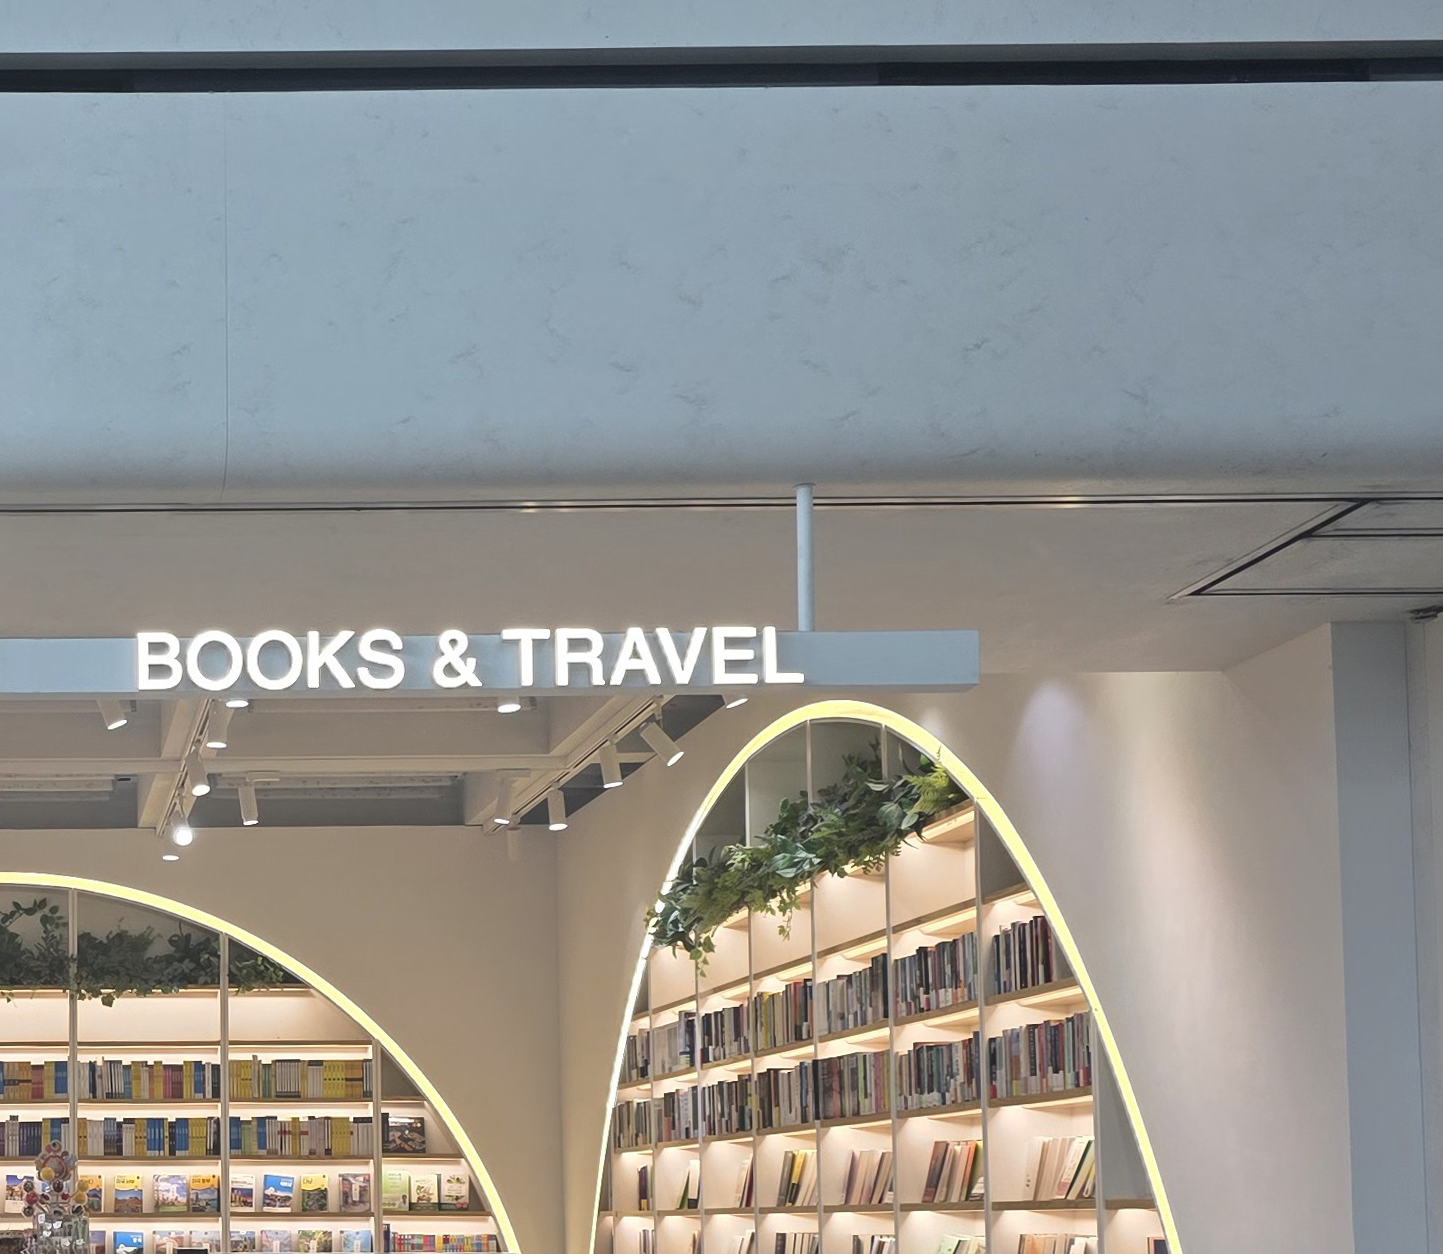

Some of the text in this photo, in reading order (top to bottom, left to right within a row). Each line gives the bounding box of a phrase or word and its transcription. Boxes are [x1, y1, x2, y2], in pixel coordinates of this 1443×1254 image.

[137, 626, 805, 691] BOOKS & TRAVEL
